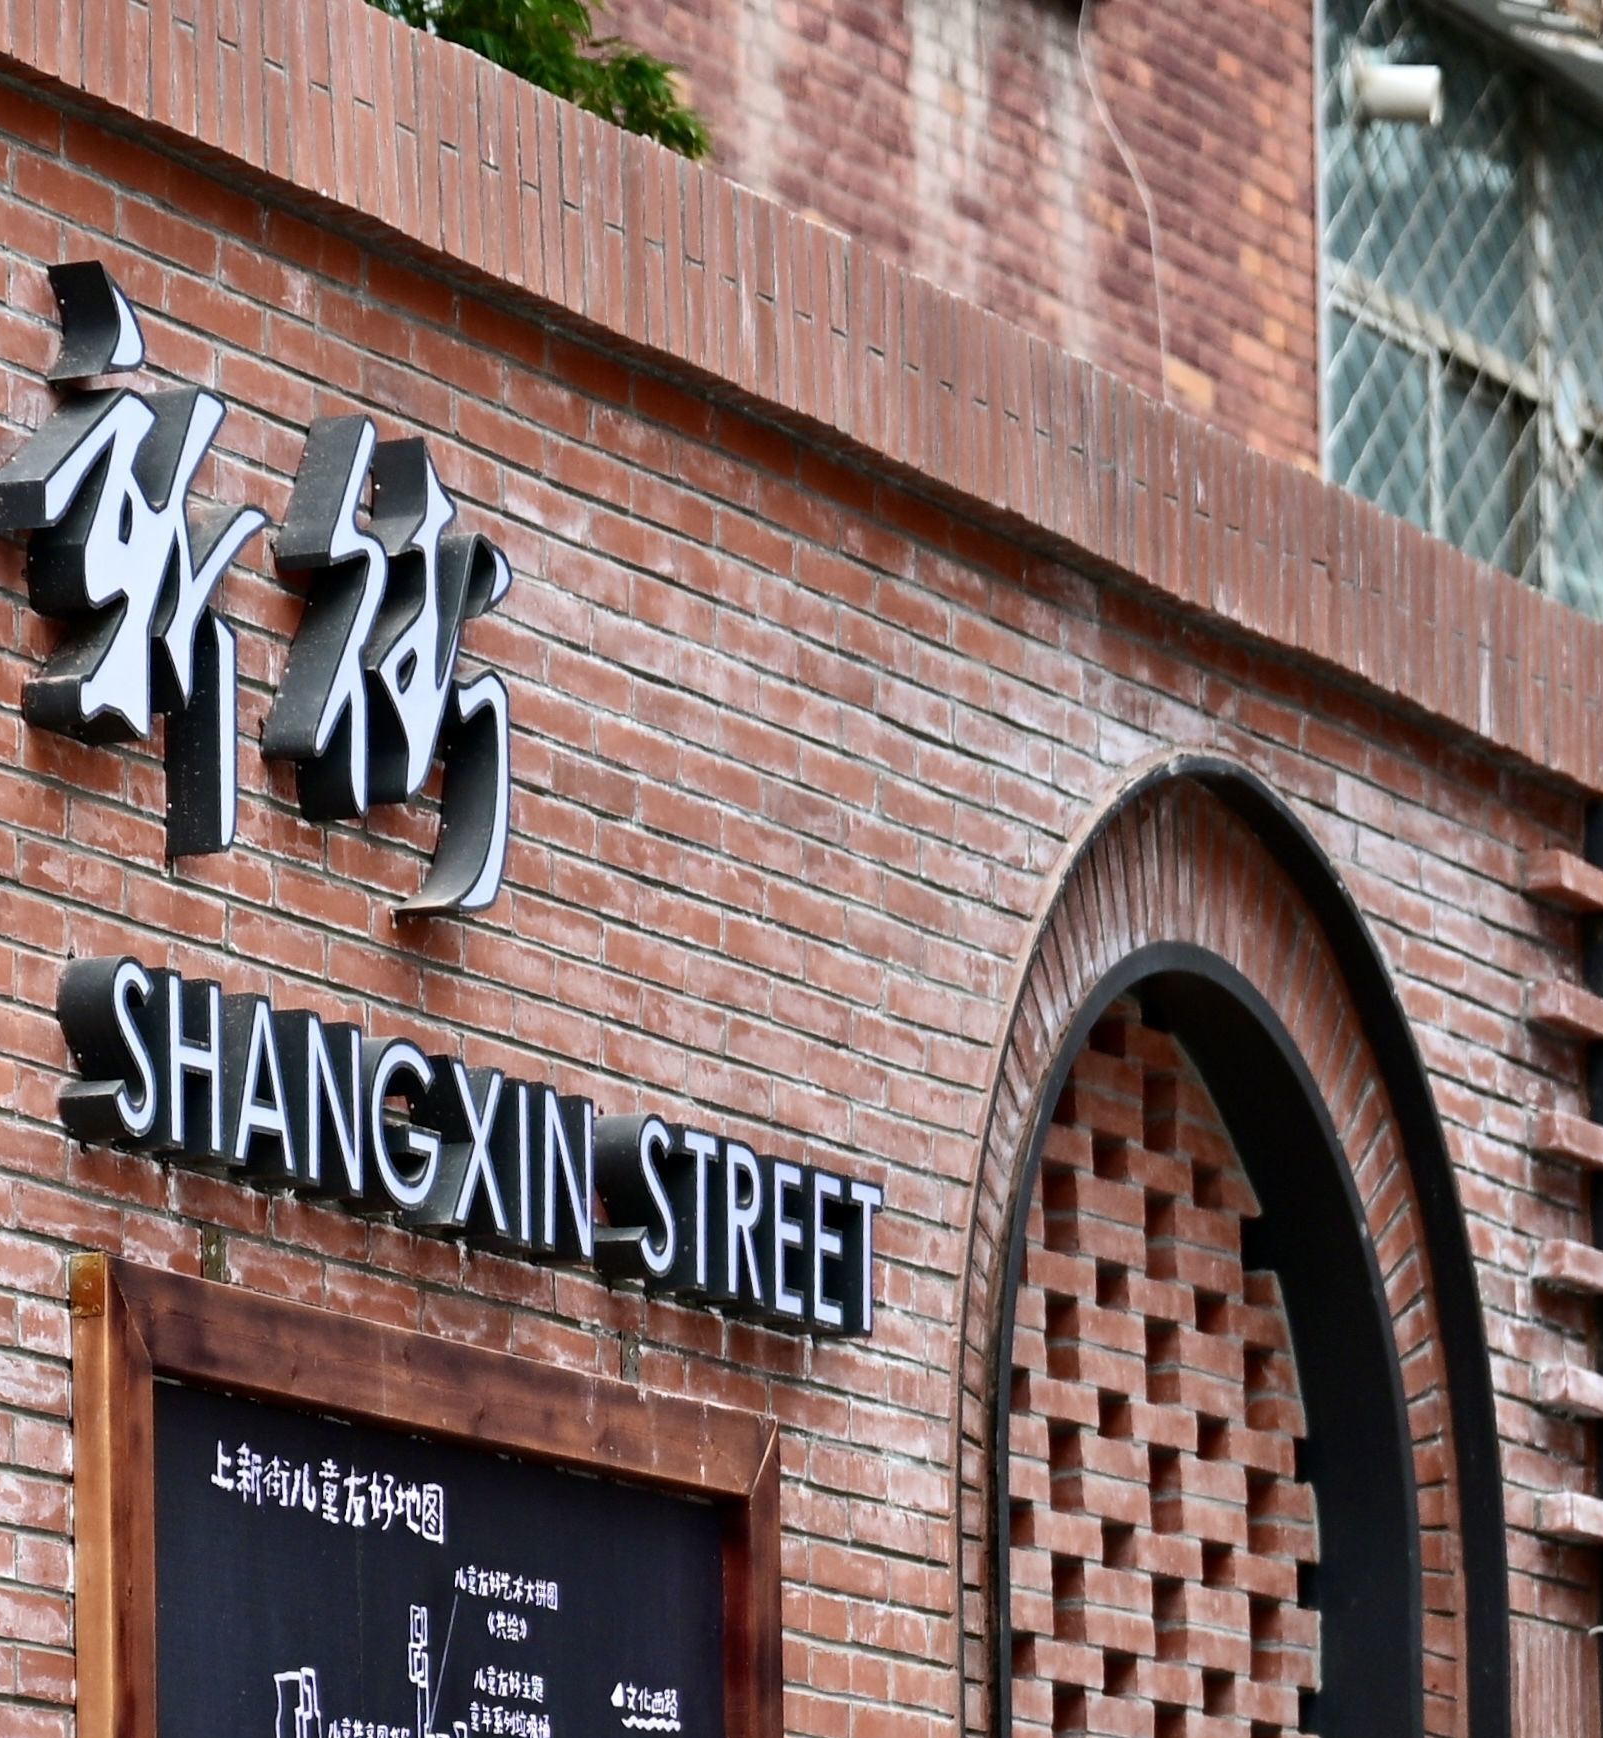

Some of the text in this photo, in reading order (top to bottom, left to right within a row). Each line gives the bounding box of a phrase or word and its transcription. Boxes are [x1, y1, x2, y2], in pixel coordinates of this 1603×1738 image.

[111, 958, 884, 1337] SHANGXIN STREET
[210, 1439, 445, 1545] 上新街儿童友好地图
[454, 1564, 558, 1611] 儿童友好艺术大拼图
[473, 1664, 544, 1704] 儿童友好主题
[625, 1681, 679, 1720] 文化西路
